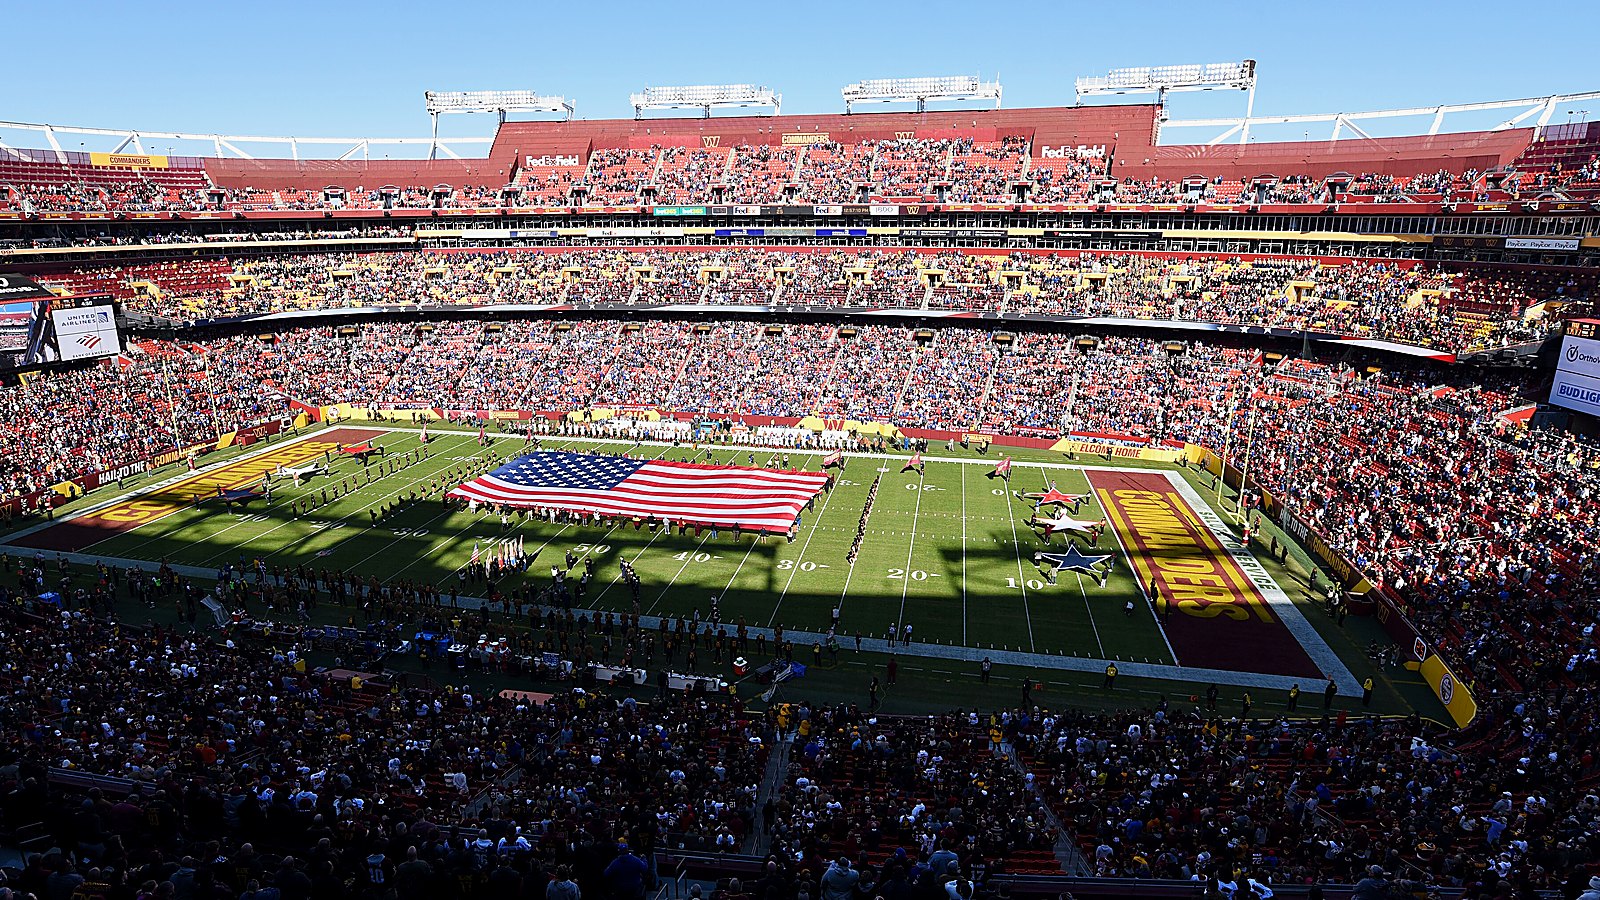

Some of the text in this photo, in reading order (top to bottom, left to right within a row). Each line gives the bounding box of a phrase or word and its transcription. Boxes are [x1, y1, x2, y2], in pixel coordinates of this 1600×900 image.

[782, 134, 829, 144] COMMANDERS
[1041, 144, 1106, 159] FedExField
[109, 156, 151, 165] COMMANDERS
[526, 155, 579, 167] FedExField
[734, 206, 756, 214] FedEx
[815, 206, 837, 214] FedEx
[1507, 240, 1527, 248] Paycor
[1554, 241, 1577, 249] Paycor
[61, 319, 97, 327] AIRLINES
[67, 313, 96, 321] UNITED
[1559, 385, 1580, 398] BUD
[1114, 447, 1142, 458] HOME
[98, 469, 118, 484] HAIL
[119, 466, 130, 476] TO
[131, 461, 145, 474] THE
[573, 543, 612, 554] 50
[1113, 488, 1250, 621] COMMANDERS
[672, 551, 711, 563] 40
[776, 559, 817, 572] 30
[1231, 551, 1278, 590] SERVICE
[886, 568, 928, 581] 20
[1004, 577, 1044, 590] 10
